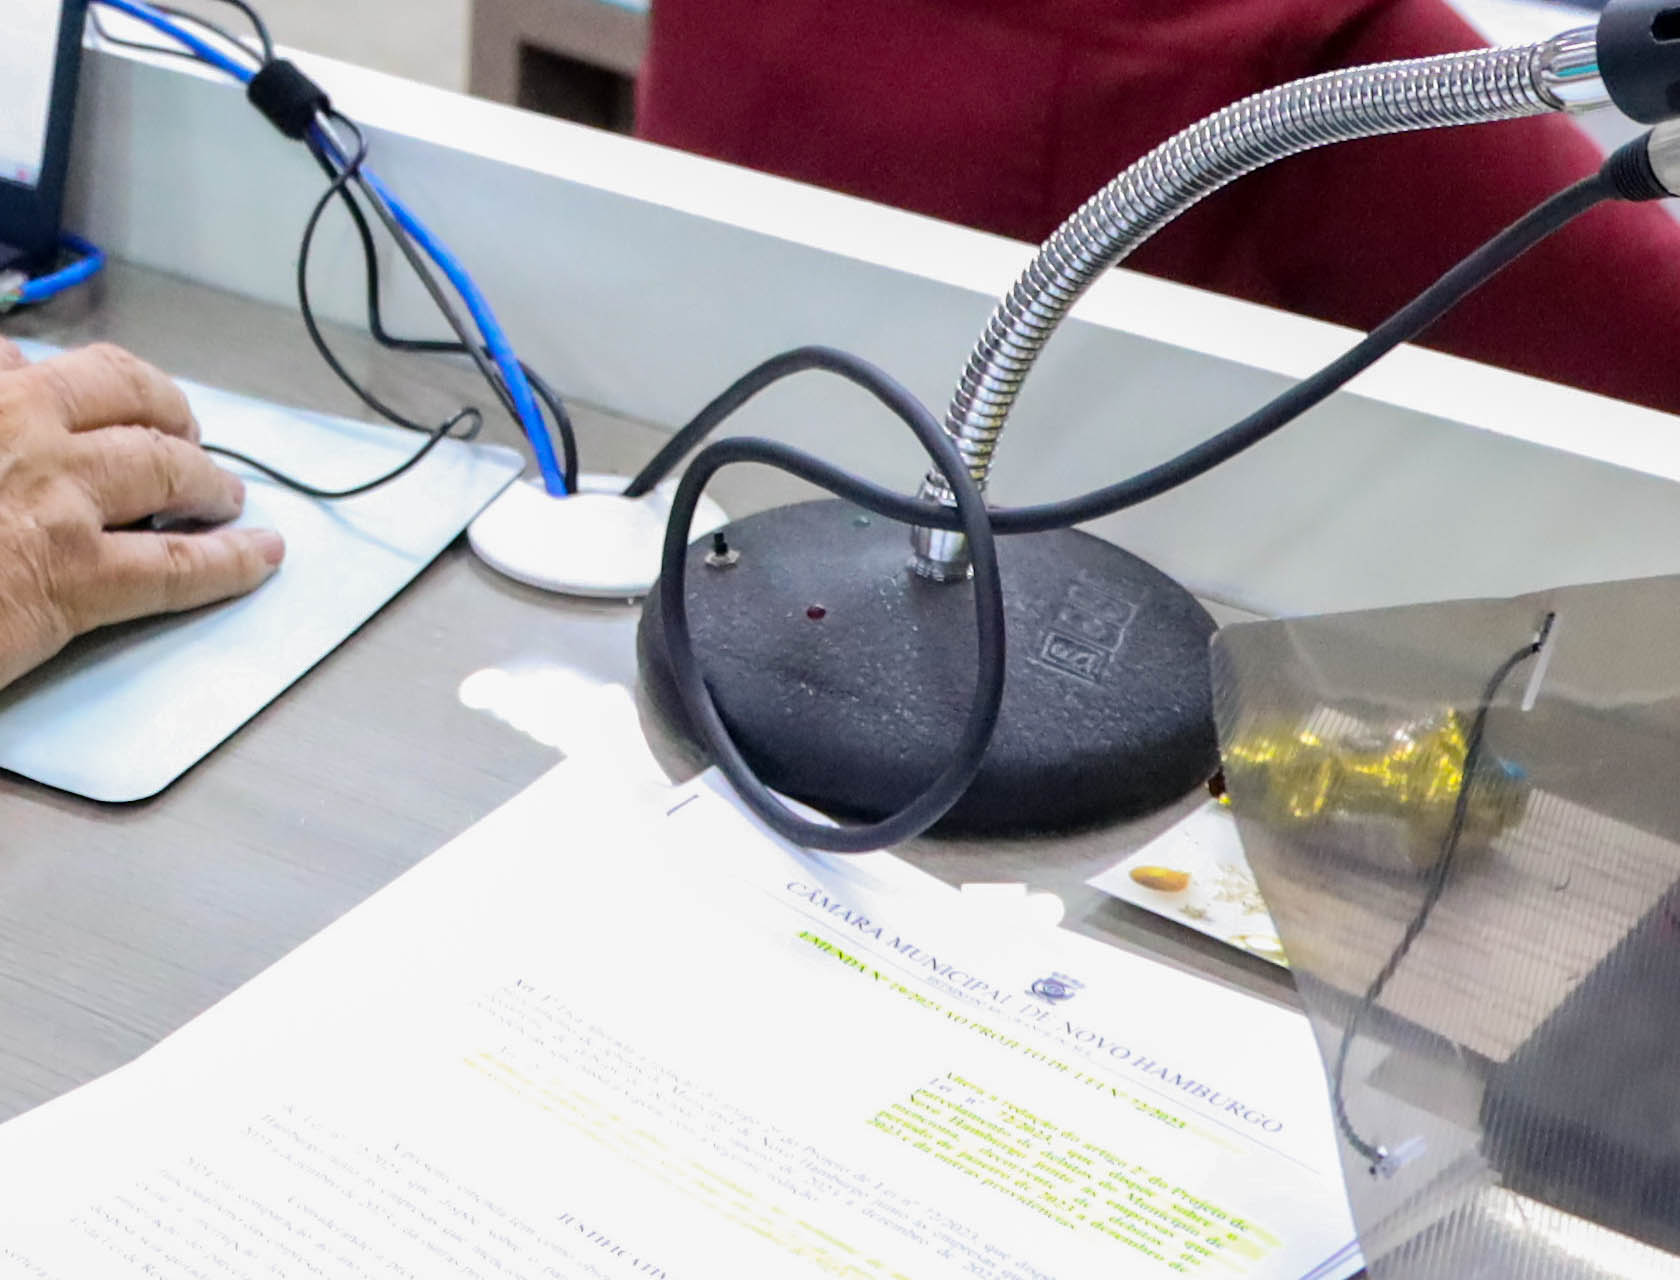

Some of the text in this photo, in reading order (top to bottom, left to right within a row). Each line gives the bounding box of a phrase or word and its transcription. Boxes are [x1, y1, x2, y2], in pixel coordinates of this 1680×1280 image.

[786, 880, 883, 940] CÂMARA
[887, 935, 1014, 1006] MUNICIPAL
[1019, 1003, 1050, 1022] DE
[1060, 1021, 1131, 1060] NOVO
[1131, 1055, 1283, 1133] HAMBURGO
[557, 1212, 668, 1280] JUSTIFICATIV
